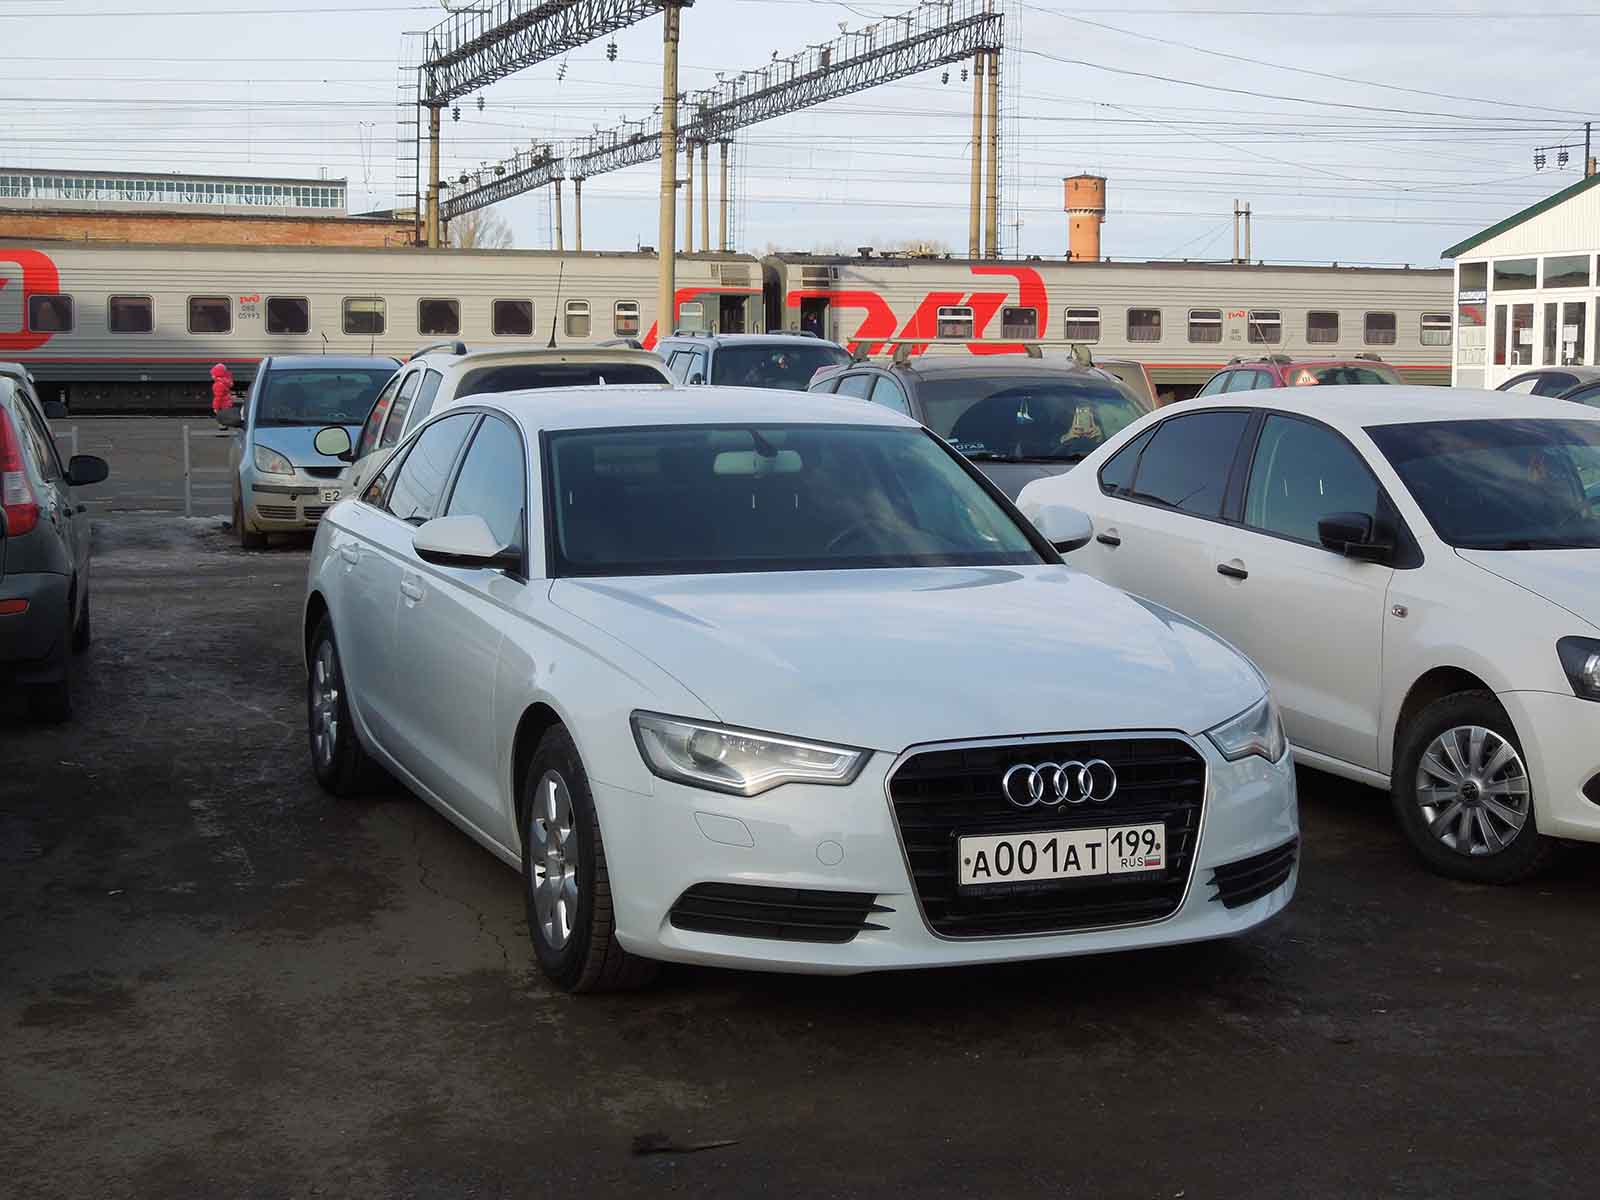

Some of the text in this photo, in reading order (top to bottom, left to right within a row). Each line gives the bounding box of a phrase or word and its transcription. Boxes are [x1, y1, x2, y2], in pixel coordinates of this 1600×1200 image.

[971, 828, 1156, 878] A001AT 199
[1121, 857, 1143, 868] RUS
